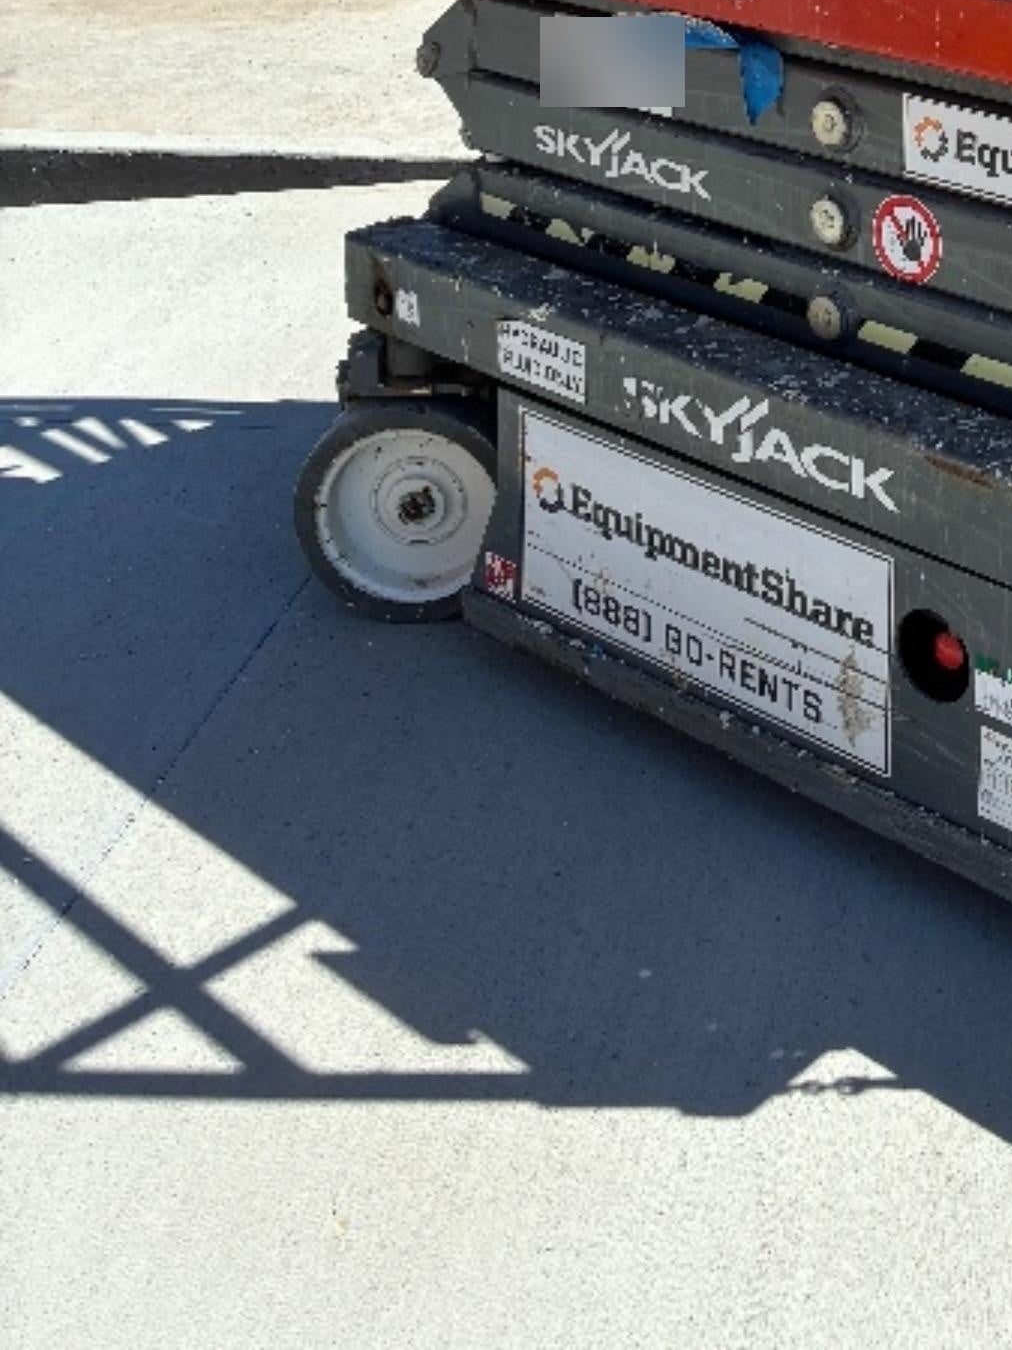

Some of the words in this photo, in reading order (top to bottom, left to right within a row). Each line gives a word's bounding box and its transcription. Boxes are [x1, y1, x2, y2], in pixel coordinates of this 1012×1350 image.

[533, 124, 712, 201] SKYJACK
[571, 484, 875, 648] EquipmentShare
[572, 578, 652, 643] (888)
[664, 623, 824, 724] GO-RENTS
